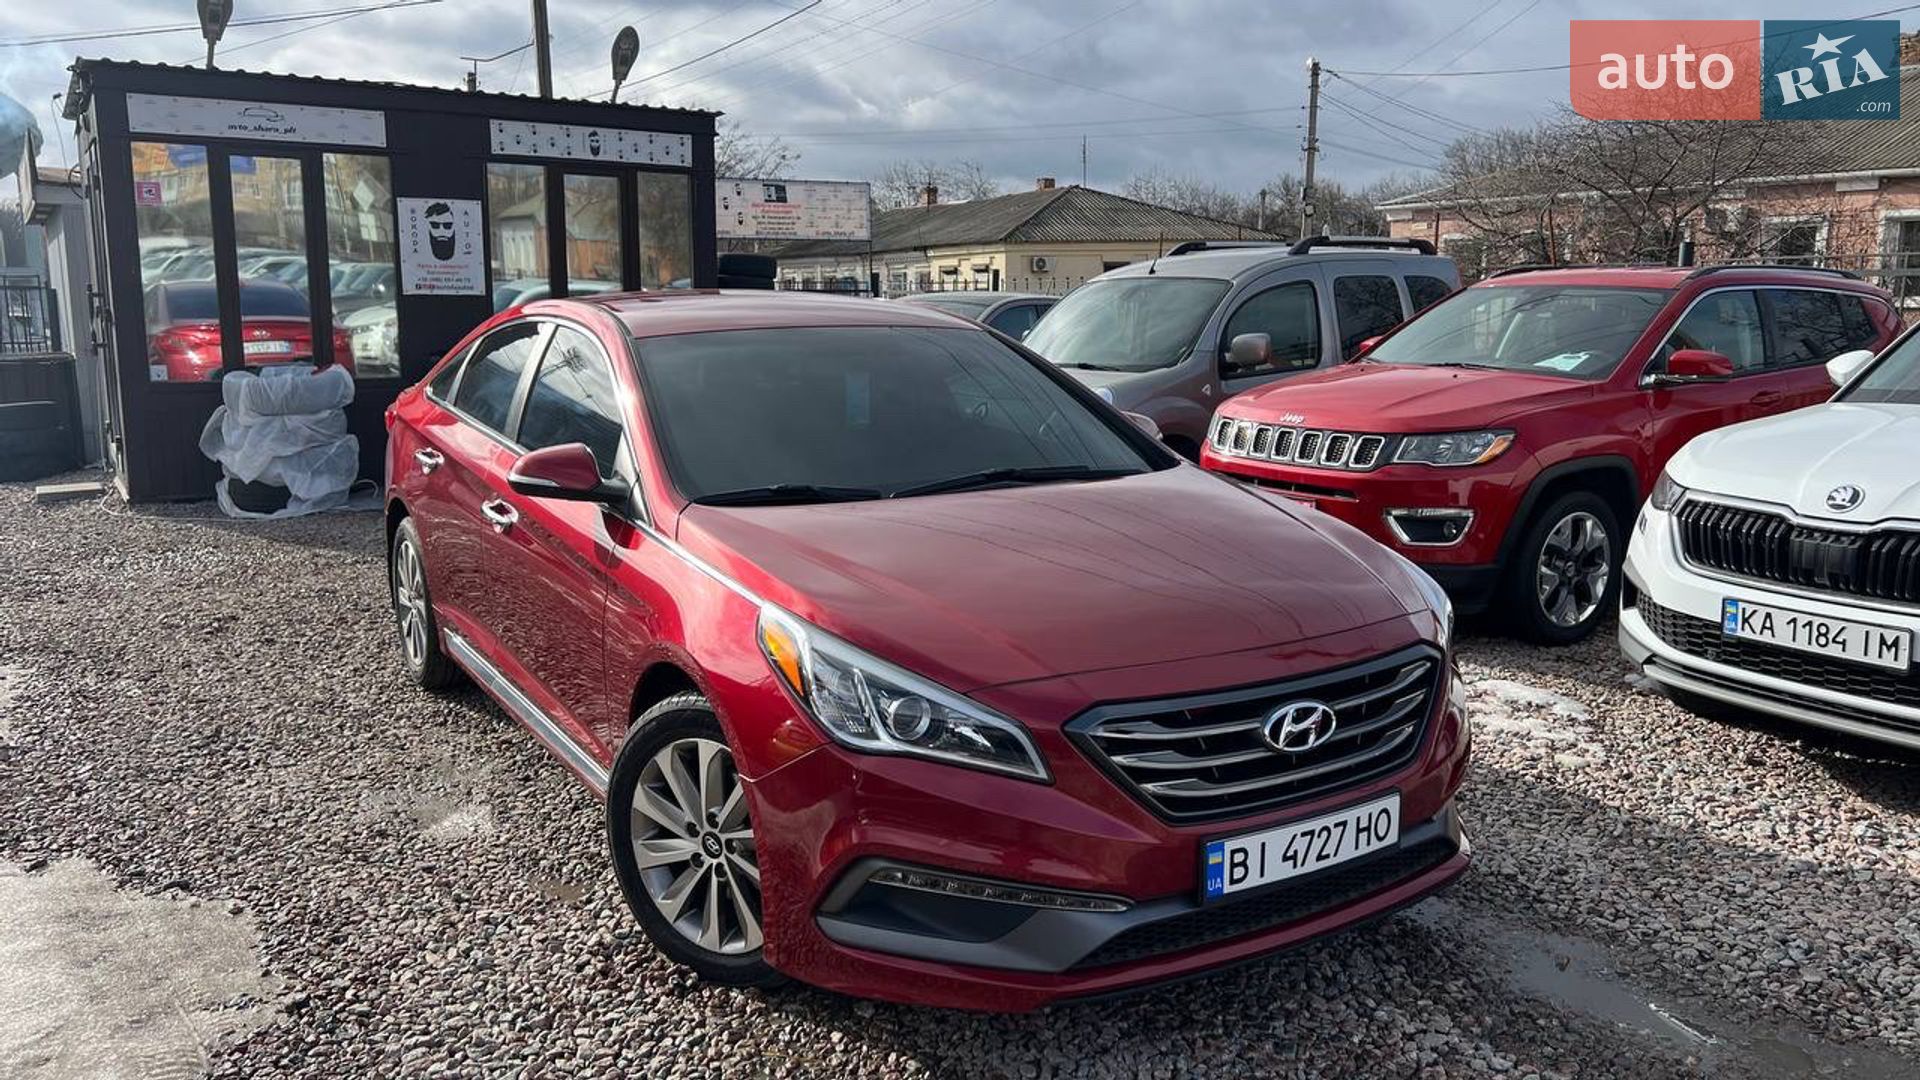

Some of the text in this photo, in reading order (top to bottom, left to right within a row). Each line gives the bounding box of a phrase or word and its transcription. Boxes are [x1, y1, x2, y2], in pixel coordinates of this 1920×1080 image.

[1280, 411, 1305, 424] Jeep
[1741, 607, 1901, 662] KA 1184 IM
[1228, 807, 1391, 886] BI 4727 HO
[1207, 877, 1222, 891] UA
